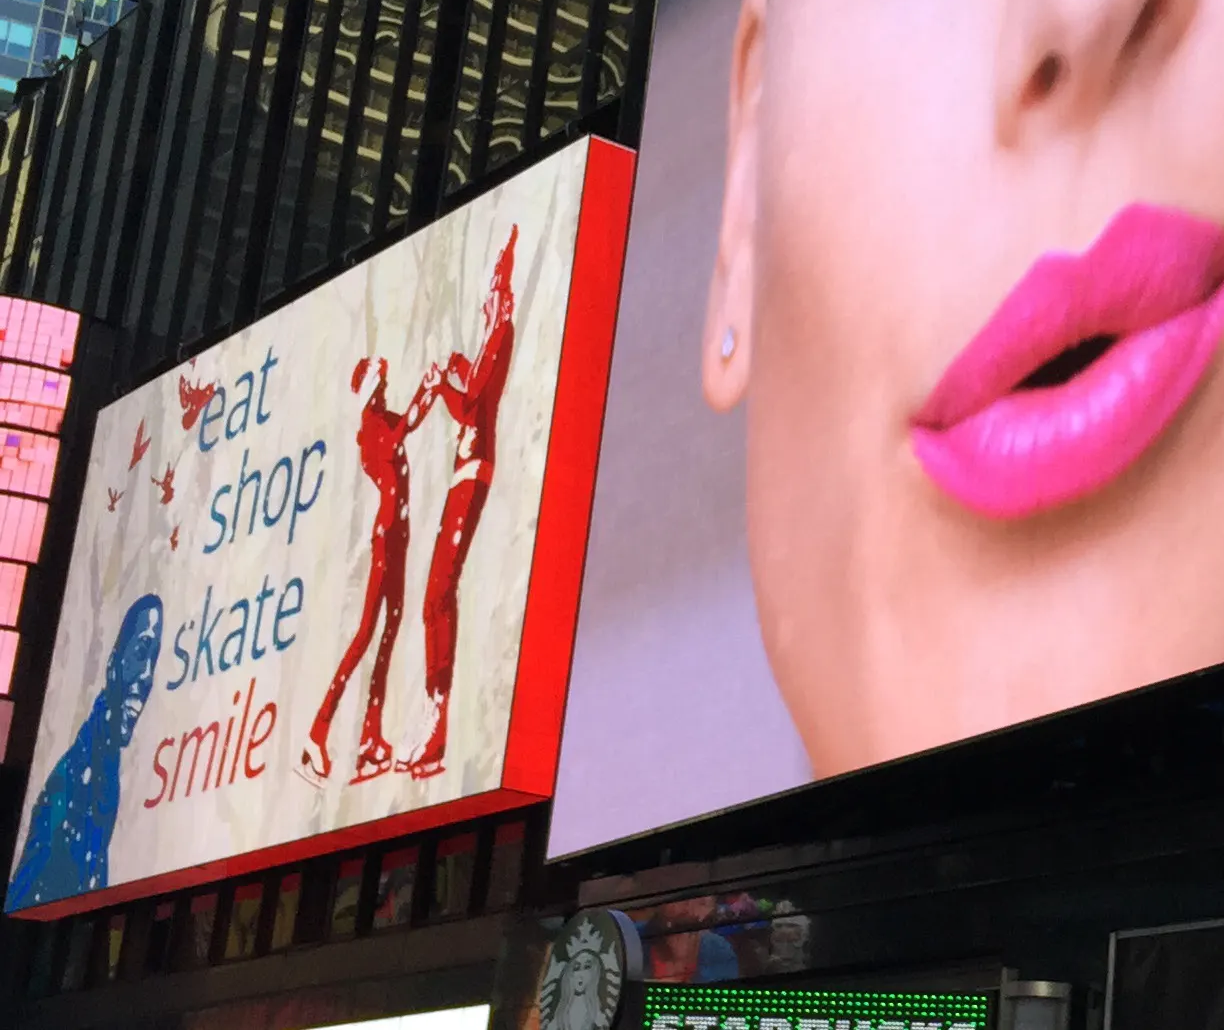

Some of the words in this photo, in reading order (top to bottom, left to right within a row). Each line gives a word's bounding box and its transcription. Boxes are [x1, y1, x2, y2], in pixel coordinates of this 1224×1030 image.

[199, 345, 279, 452] eat
[202, 439, 327, 554] shop
[165, 573, 304, 691] skate
[143, 677, 277, 809] smile
